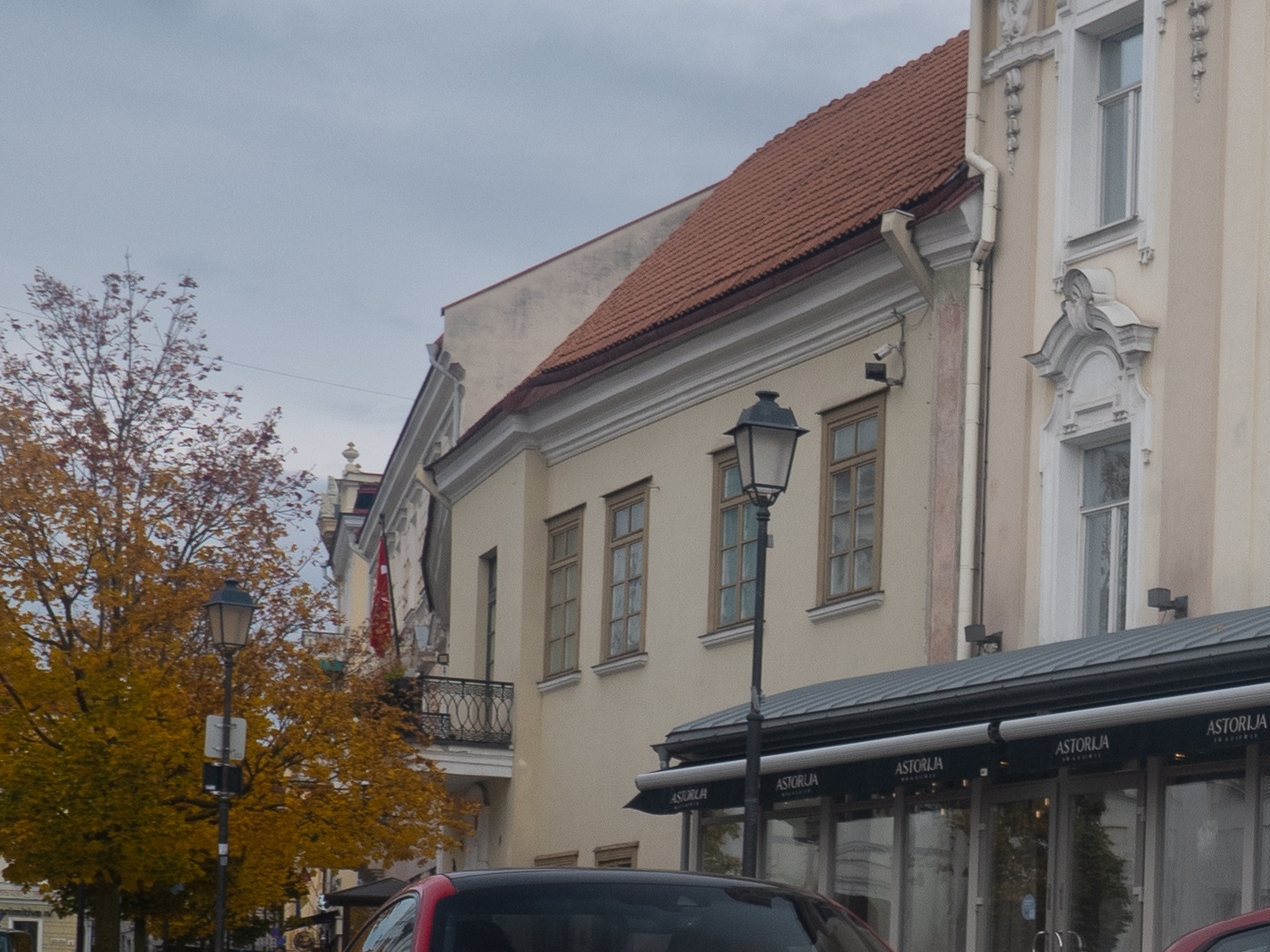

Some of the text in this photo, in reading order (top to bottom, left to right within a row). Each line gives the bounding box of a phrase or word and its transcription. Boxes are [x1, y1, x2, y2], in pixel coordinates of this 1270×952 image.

[1206, 713, 1268, 736] ASTORIJA
[1055, 734, 1110, 755] ASTORIJA
[895, 756, 944, 776] ASTORIJA
